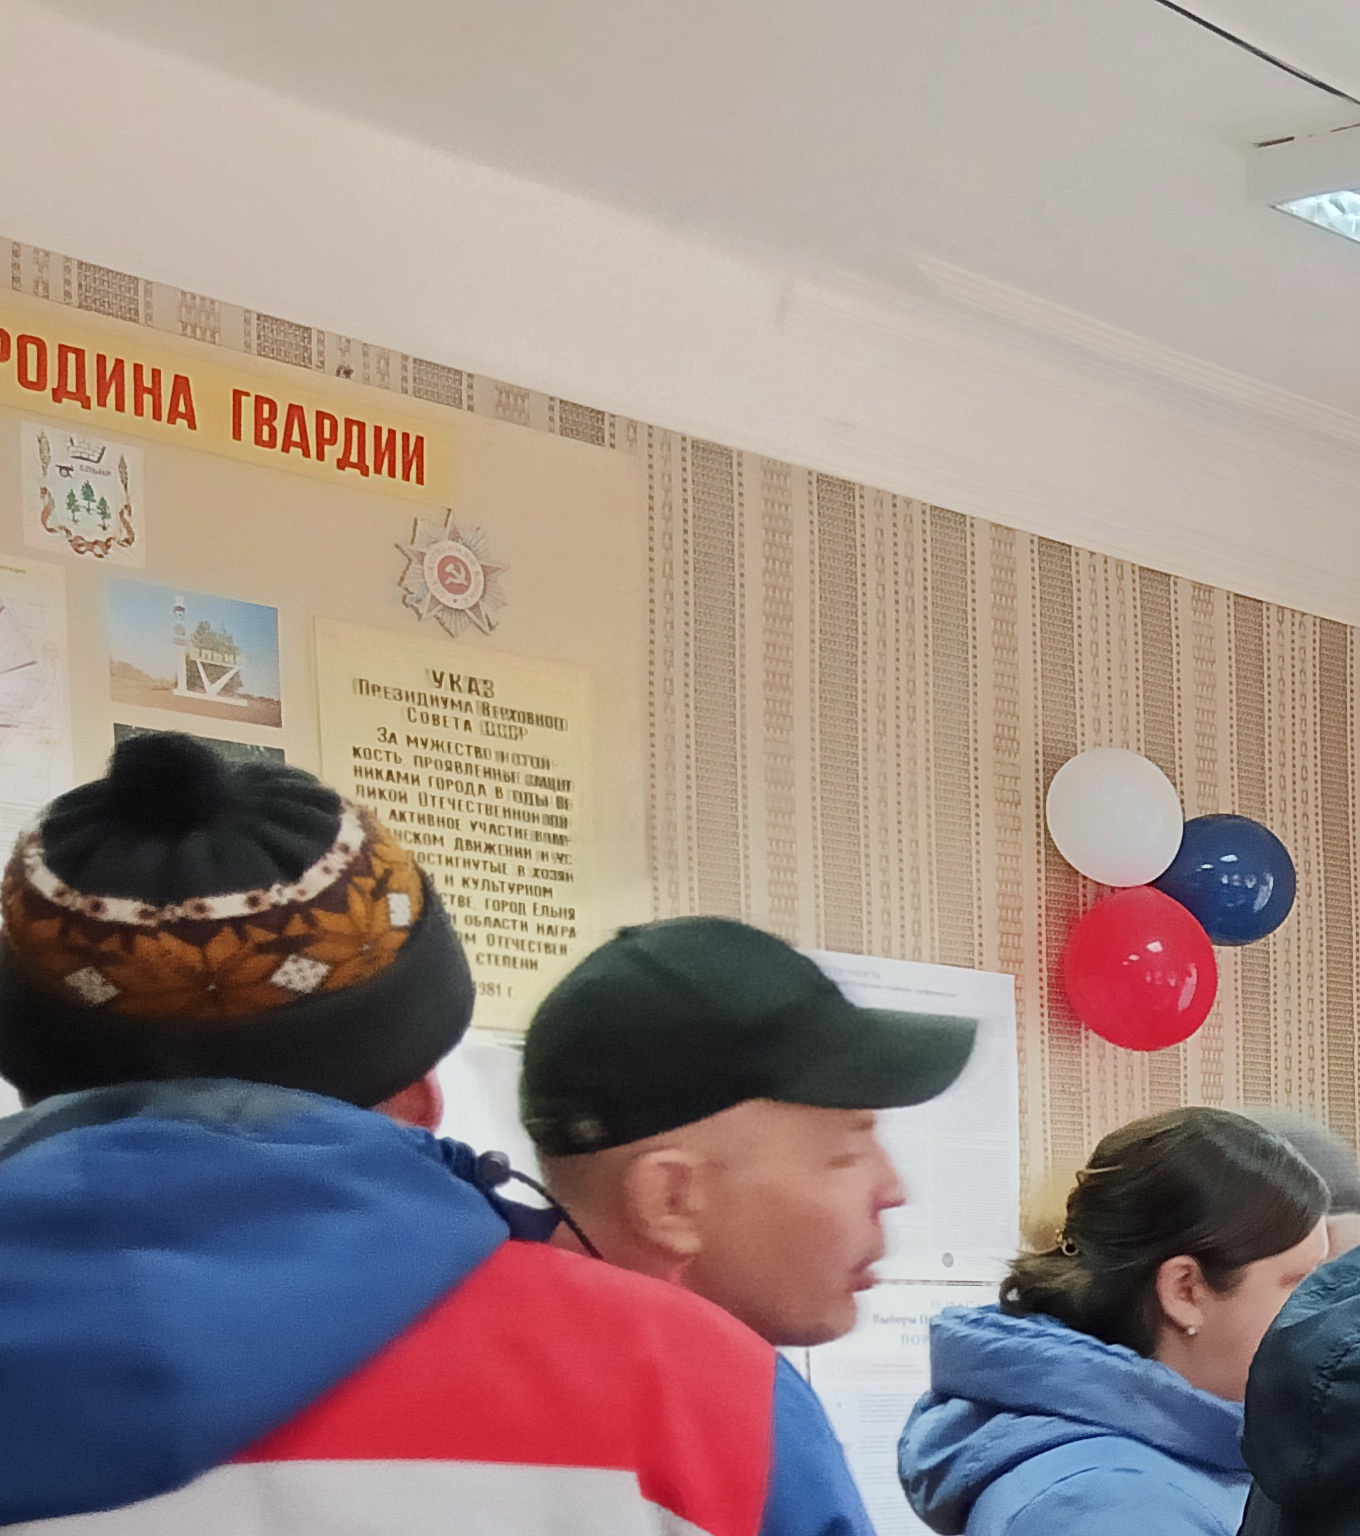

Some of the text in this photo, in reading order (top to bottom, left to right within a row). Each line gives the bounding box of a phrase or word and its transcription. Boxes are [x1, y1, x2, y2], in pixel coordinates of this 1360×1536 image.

[231, 387, 425, 486] ГВАРДИИ
[355, 678, 475, 715] ПРЕЗИДИУМА
[430, 669, 495, 699] УКАЗ
[406, 706, 473, 734] СОВЕТА
[376, 726, 399, 745] ЗА
[406, 734, 492, 761] МУЖЕСТВО
[353, 764, 421, 787] НИКАМИ
[428, 775, 487, 798] ГОРОДА
[495, 785, 504, 800] В
[413, 754, 520, 784] ПРОЯВЛЕННЫЕ
[355, 783, 408, 805] ЛИКОЙ
[417, 790, 540, 824] ОТЕЧЕСТВЕННОЙ
[388, 808, 461, 832] АКТИВНОЕ
[469, 820, 529, 841] УЧАСТИЕ
[453, 836, 532, 861] ДВИЖЕНИИ
[516, 864, 526, 878] В
[461, 875, 554, 900] КУЛЬТУРНОМ
[463, 913, 529, 934] ОБЛАСТИ
[484, 897, 527, 917] ГОРОД
[532, 901, 576, 921] ЕЛЬНЯ
